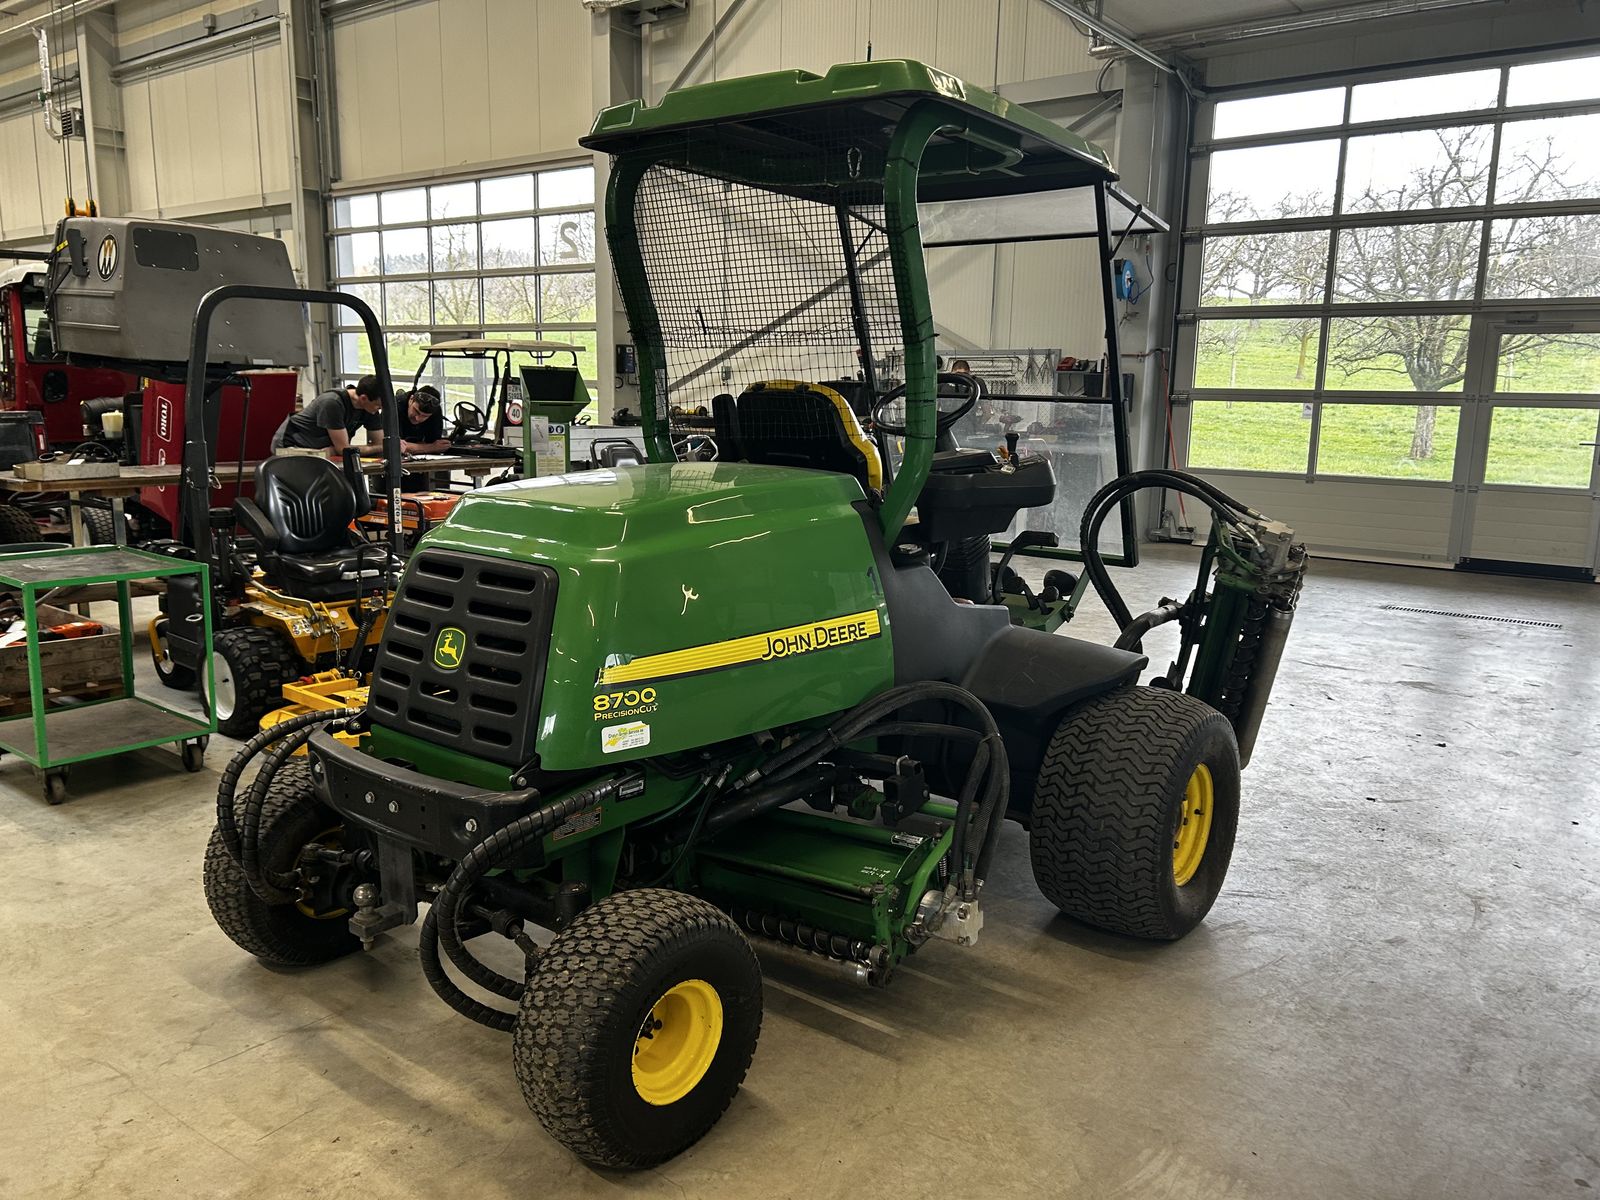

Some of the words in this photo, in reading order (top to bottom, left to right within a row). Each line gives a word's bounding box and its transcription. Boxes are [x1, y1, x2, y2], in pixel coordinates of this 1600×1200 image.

[160, 402, 168, 436] TORO
[511, 408, 521, 419] 40
[593, 687, 657, 711] 8700
